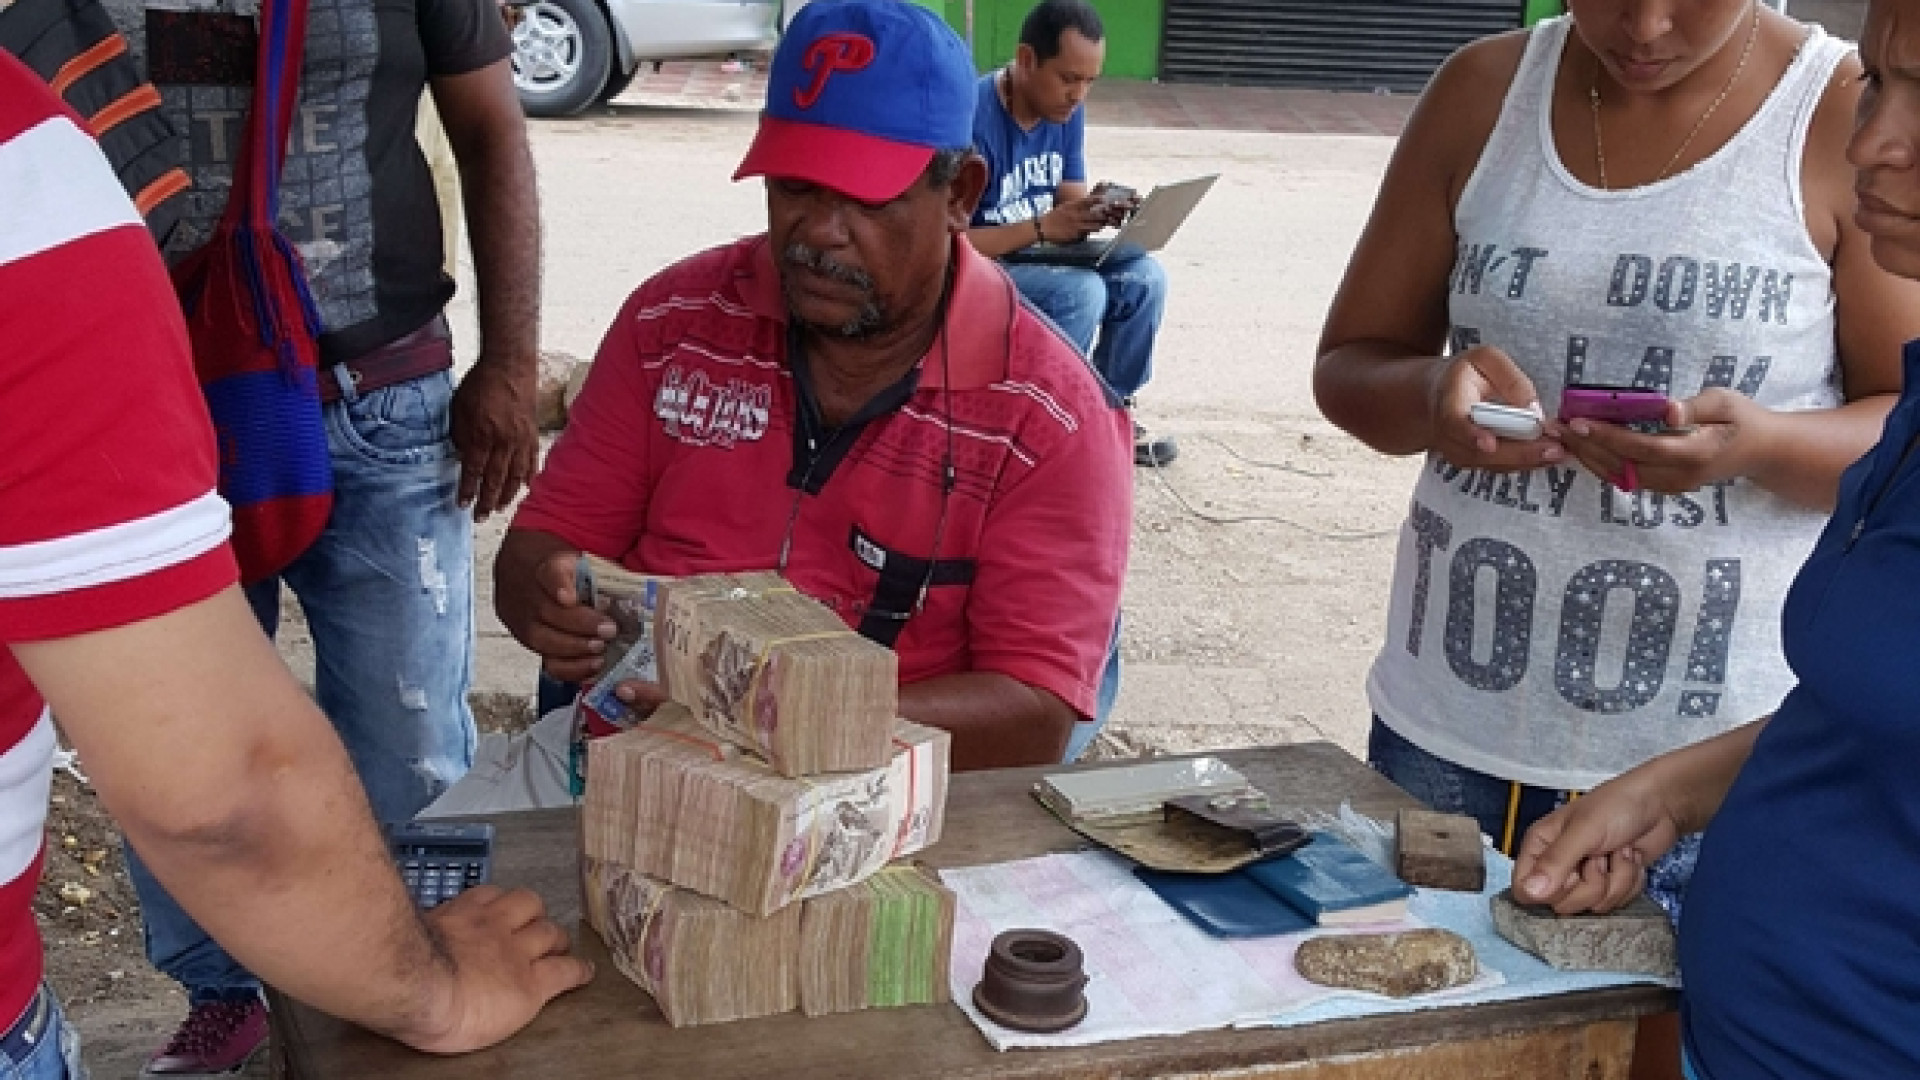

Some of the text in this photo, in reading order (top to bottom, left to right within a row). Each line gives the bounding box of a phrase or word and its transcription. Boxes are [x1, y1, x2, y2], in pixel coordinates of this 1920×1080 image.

[793, 31, 874, 110] P
[192, 104, 338, 161] TE
[1606, 253, 1794, 325] DOWN
[1405, 500, 1742, 718] TOO!
